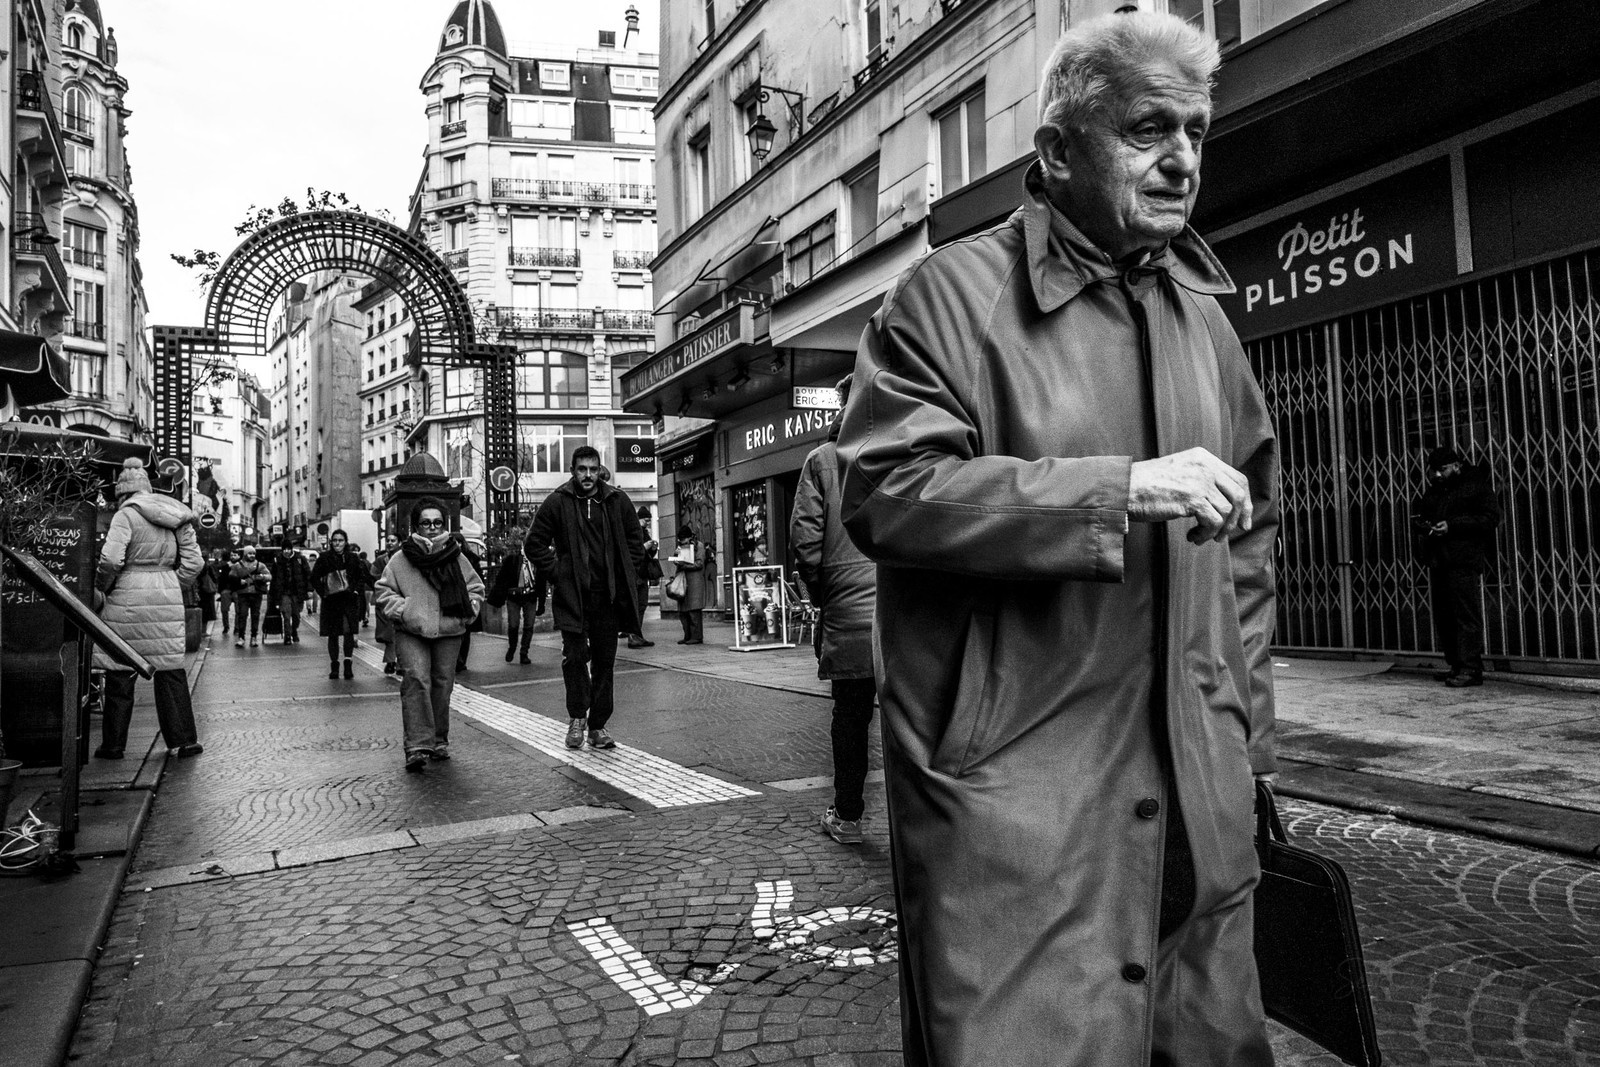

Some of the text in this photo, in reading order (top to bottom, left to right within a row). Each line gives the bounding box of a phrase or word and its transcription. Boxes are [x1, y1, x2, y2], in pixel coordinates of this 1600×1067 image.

[1278, 207, 1366, 271] Petit
[1246, 233, 1413, 312] PLISSON
[629, 321, 731, 397] BOULANGER PATISSIER
[795, 396, 818, 406] ERIC
[745, 409, 840, 450] ERIC KAYSE
[33, 536, 77, 547] NOUVEAU
